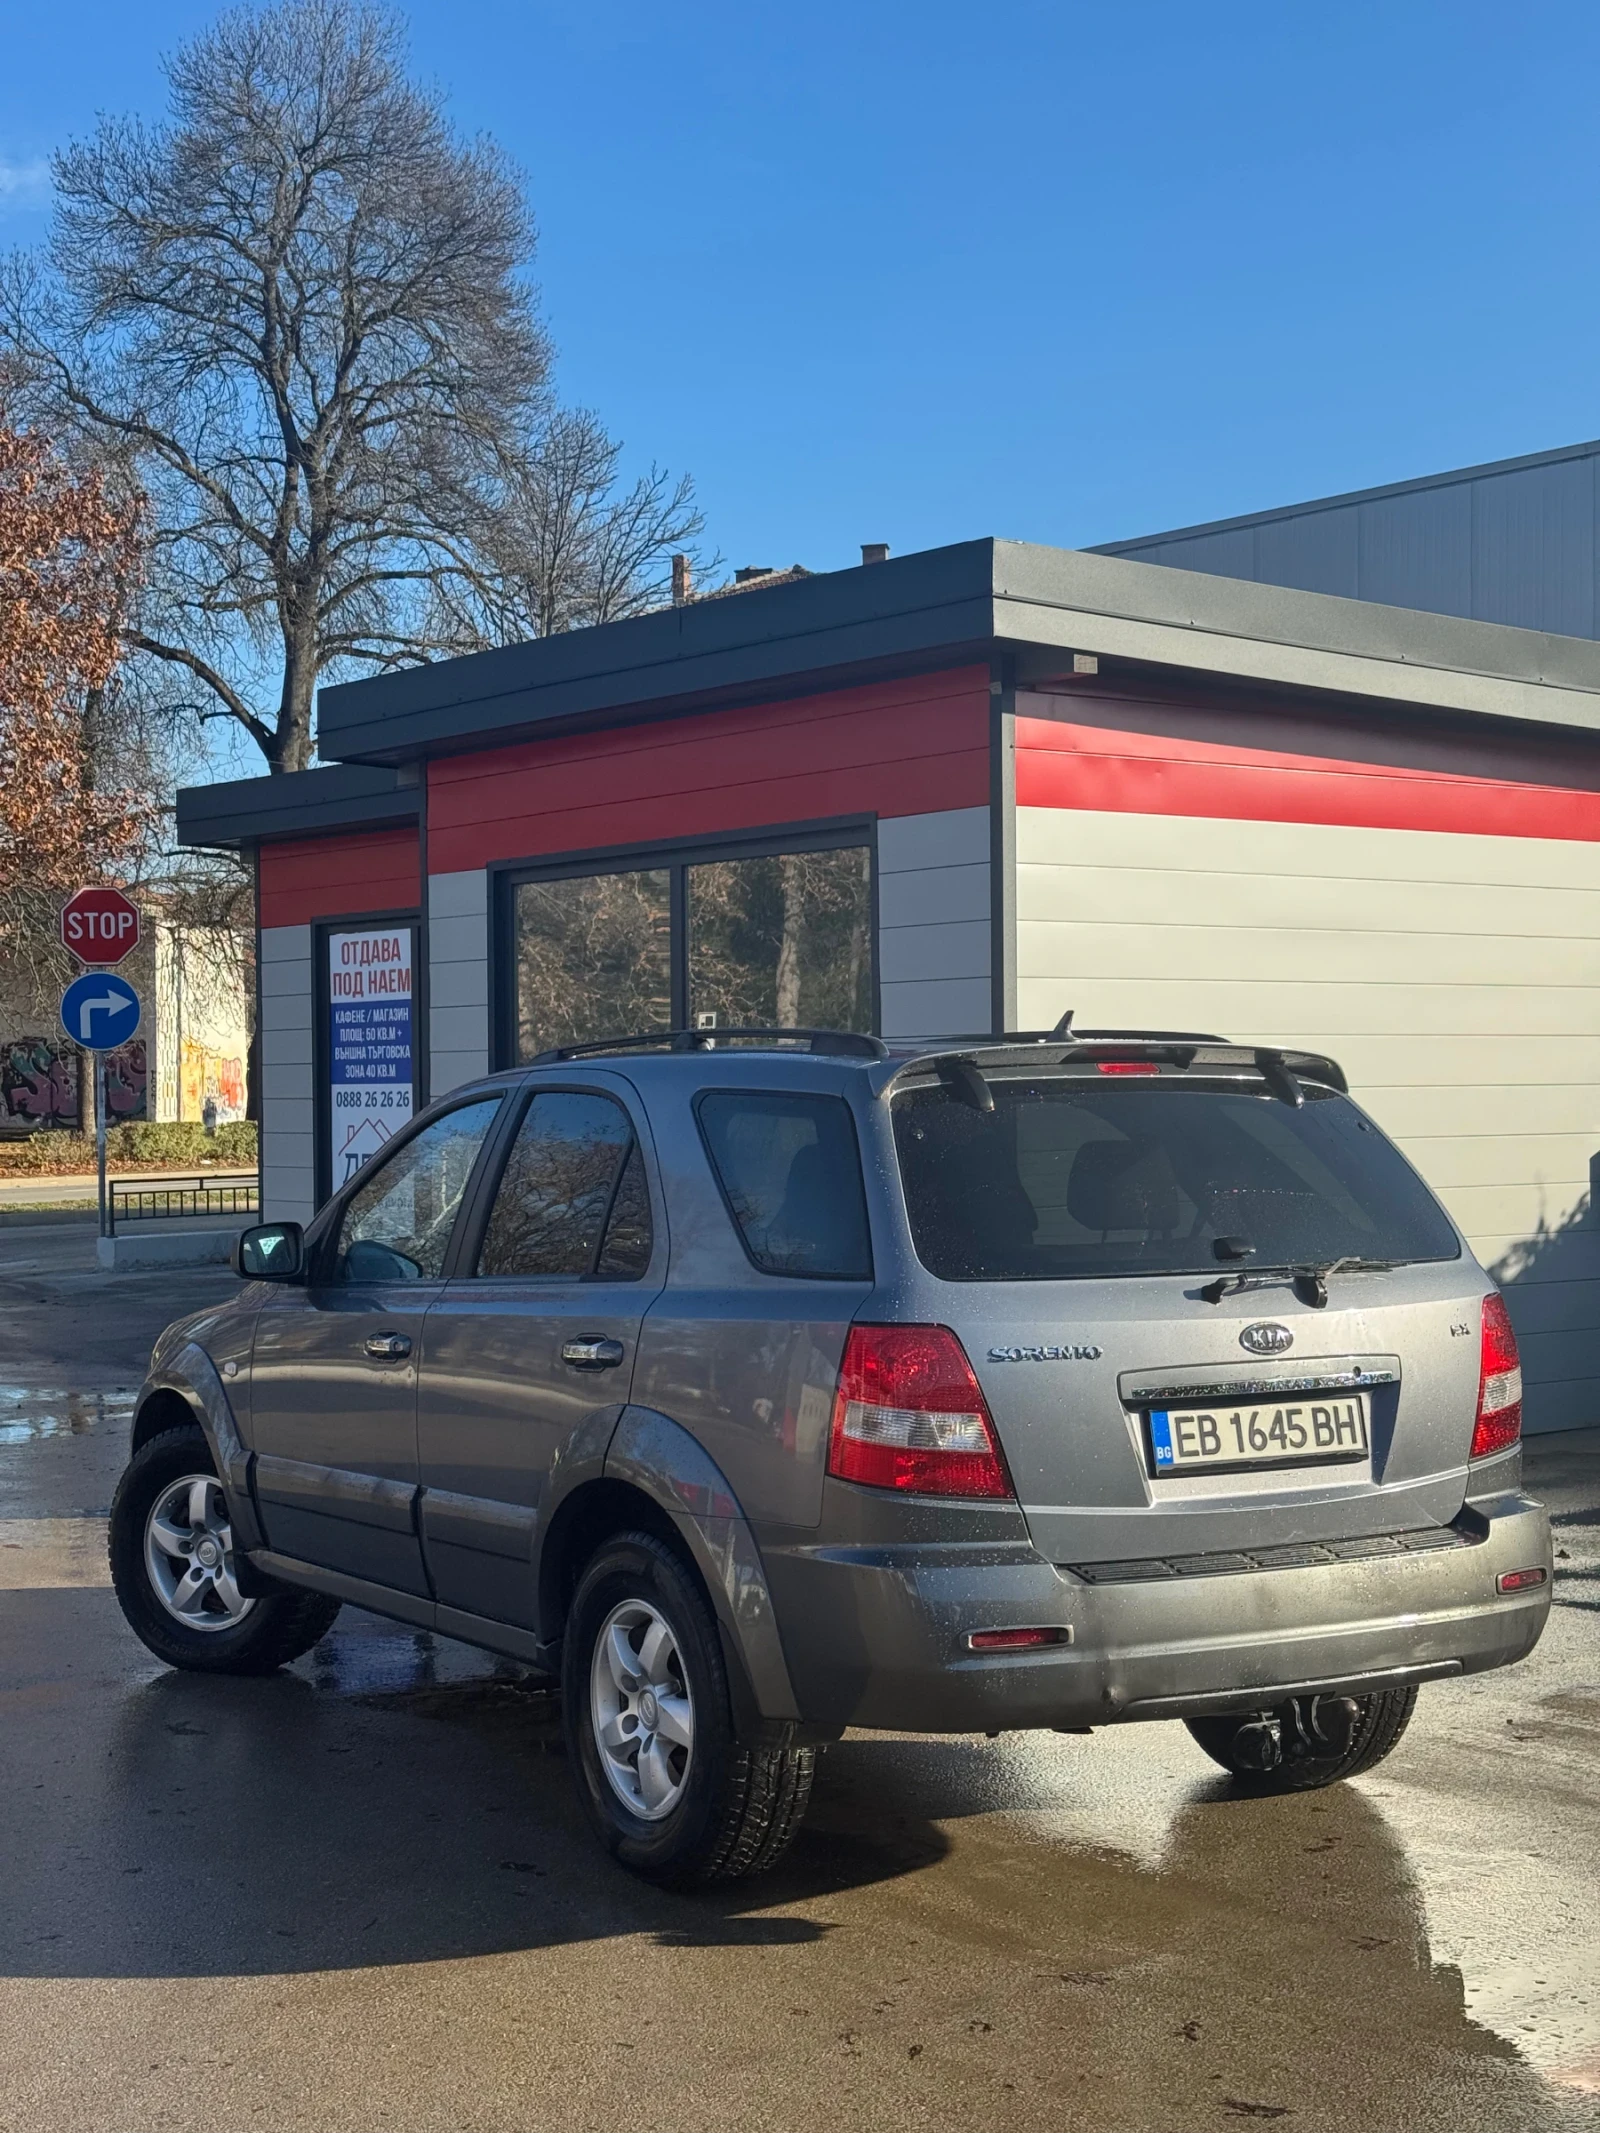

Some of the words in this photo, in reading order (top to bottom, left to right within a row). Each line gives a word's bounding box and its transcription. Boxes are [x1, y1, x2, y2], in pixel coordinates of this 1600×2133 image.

[67, 911, 134, 940] STOP
[341, 937, 402, 967] ОТДАВА
[333, 971, 364, 998] ПОД
[368, 967, 411, 995] НАЕМ
[335, 1009, 366, 1024] КАФЕНЕ
[373, 1007, 409, 1023] МАГАЗИН
[340, 1027, 365, 1042] ПЛОЩ:
[366, 1027, 376, 1041] 50
[377, 1026, 396, 1040] КВ.М
[334, 1046, 367, 1060] ВЪНШНА
[367, 1044, 411, 1059] ТЪРГОВСКА
[345, 1064, 366, 1078] ЗОНА
[366, 1064, 376, 1078] 40
[377, 1063, 396, 1077] КВ.М
[336, 1091, 362, 1108] 0888
[365, 1090, 378, 1108] 26
[380, 1090, 394, 1108] 26
[396, 1090, 410, 1108] 26
[1250, 1328, 1289, 1348] KIA
[986, 1345, 1104, 1363] SORENTO
[1174, 1414, 1222, 1458] EB
[1229, 1408, 1308, 1453] 1645
[1311, 1404, 1358, 1447] BH
[1156, 1446, 1172, 1460] BG
